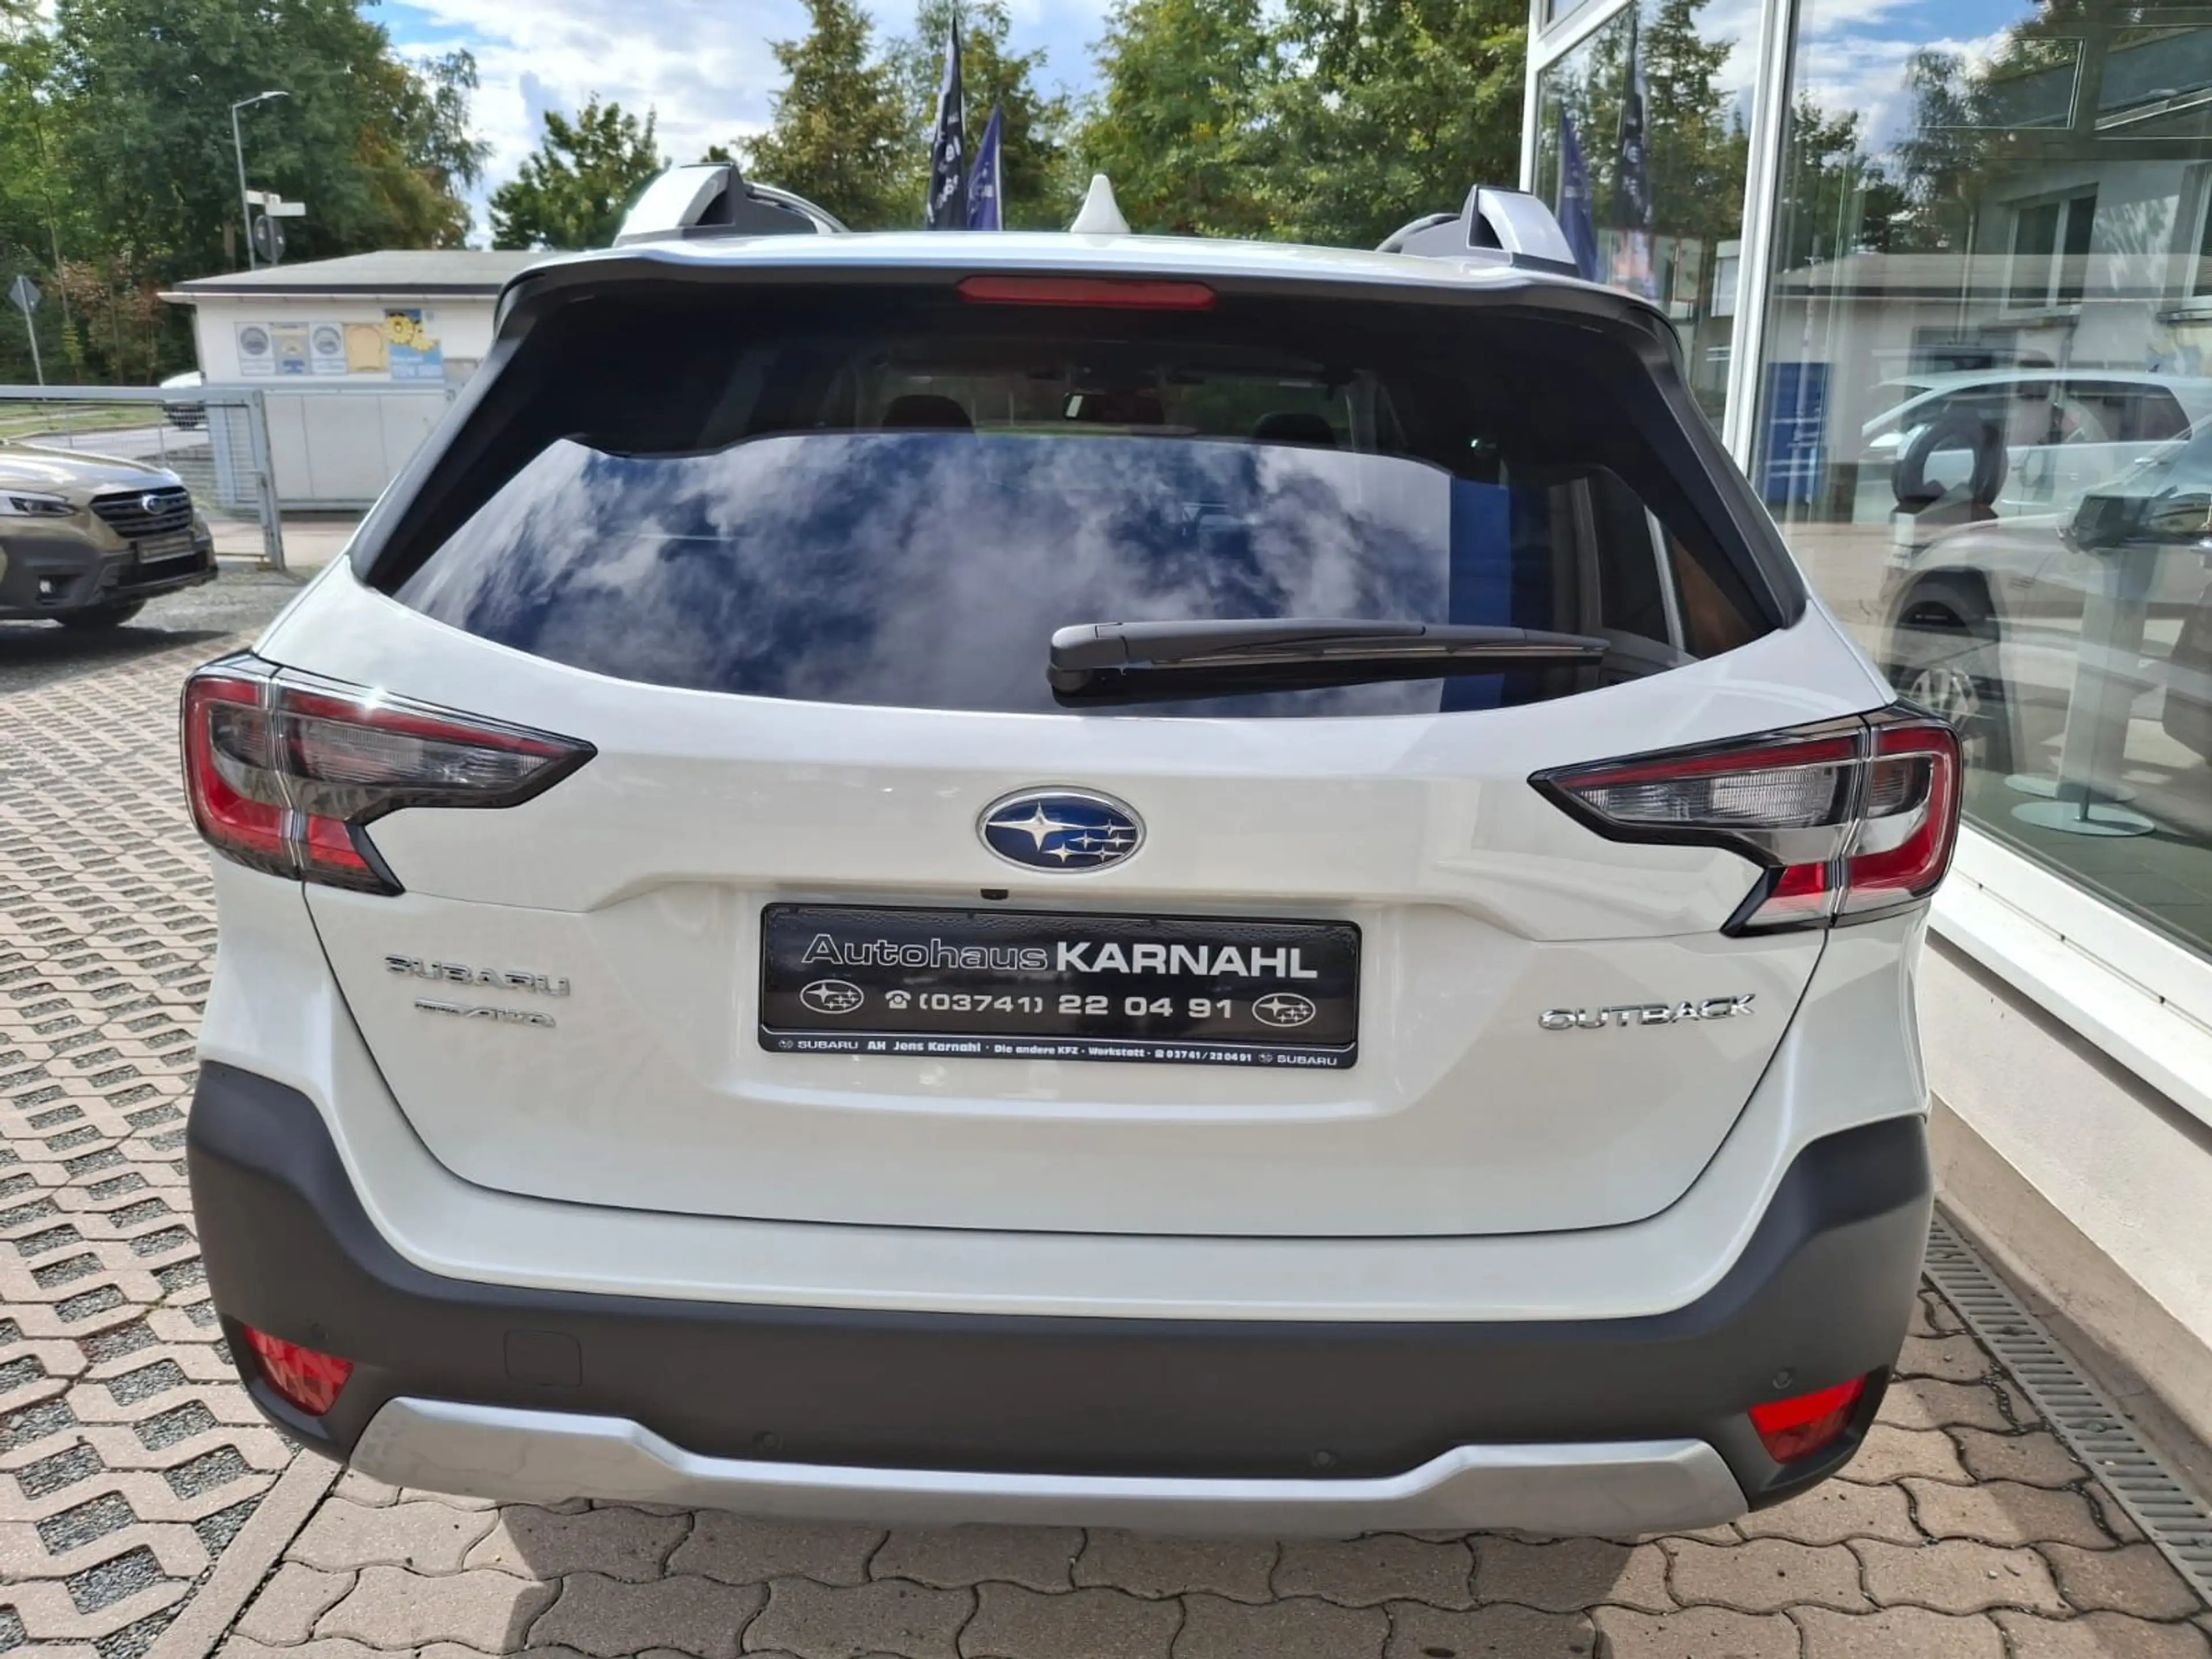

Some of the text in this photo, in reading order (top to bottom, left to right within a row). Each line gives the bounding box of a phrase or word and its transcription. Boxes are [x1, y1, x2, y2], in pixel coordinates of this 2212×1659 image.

[801, 933, 1318, 979] Autohaus KARNAHL
[384, 955, 570, 997] SUBARU
[919, 993, 1232, 1018] (03741) 22 04 91
[1537, 993, 1756, 1030] OUTBACK
[797, 1040, 858, 1050] SUBARU
[892, 1041, 924, 1051] Jens
[927, 1041, 982, 1052] Karnahl
[994, 1043, 1013, 1054] Die
[1016, 1044, 1055, 1055] andere
[1057, 1046, 1079, 1055] KFZ
[1088, 1047, 1145, 1058] Werkstatt
[1277, 1055, 1338, 1066] SUBARU
